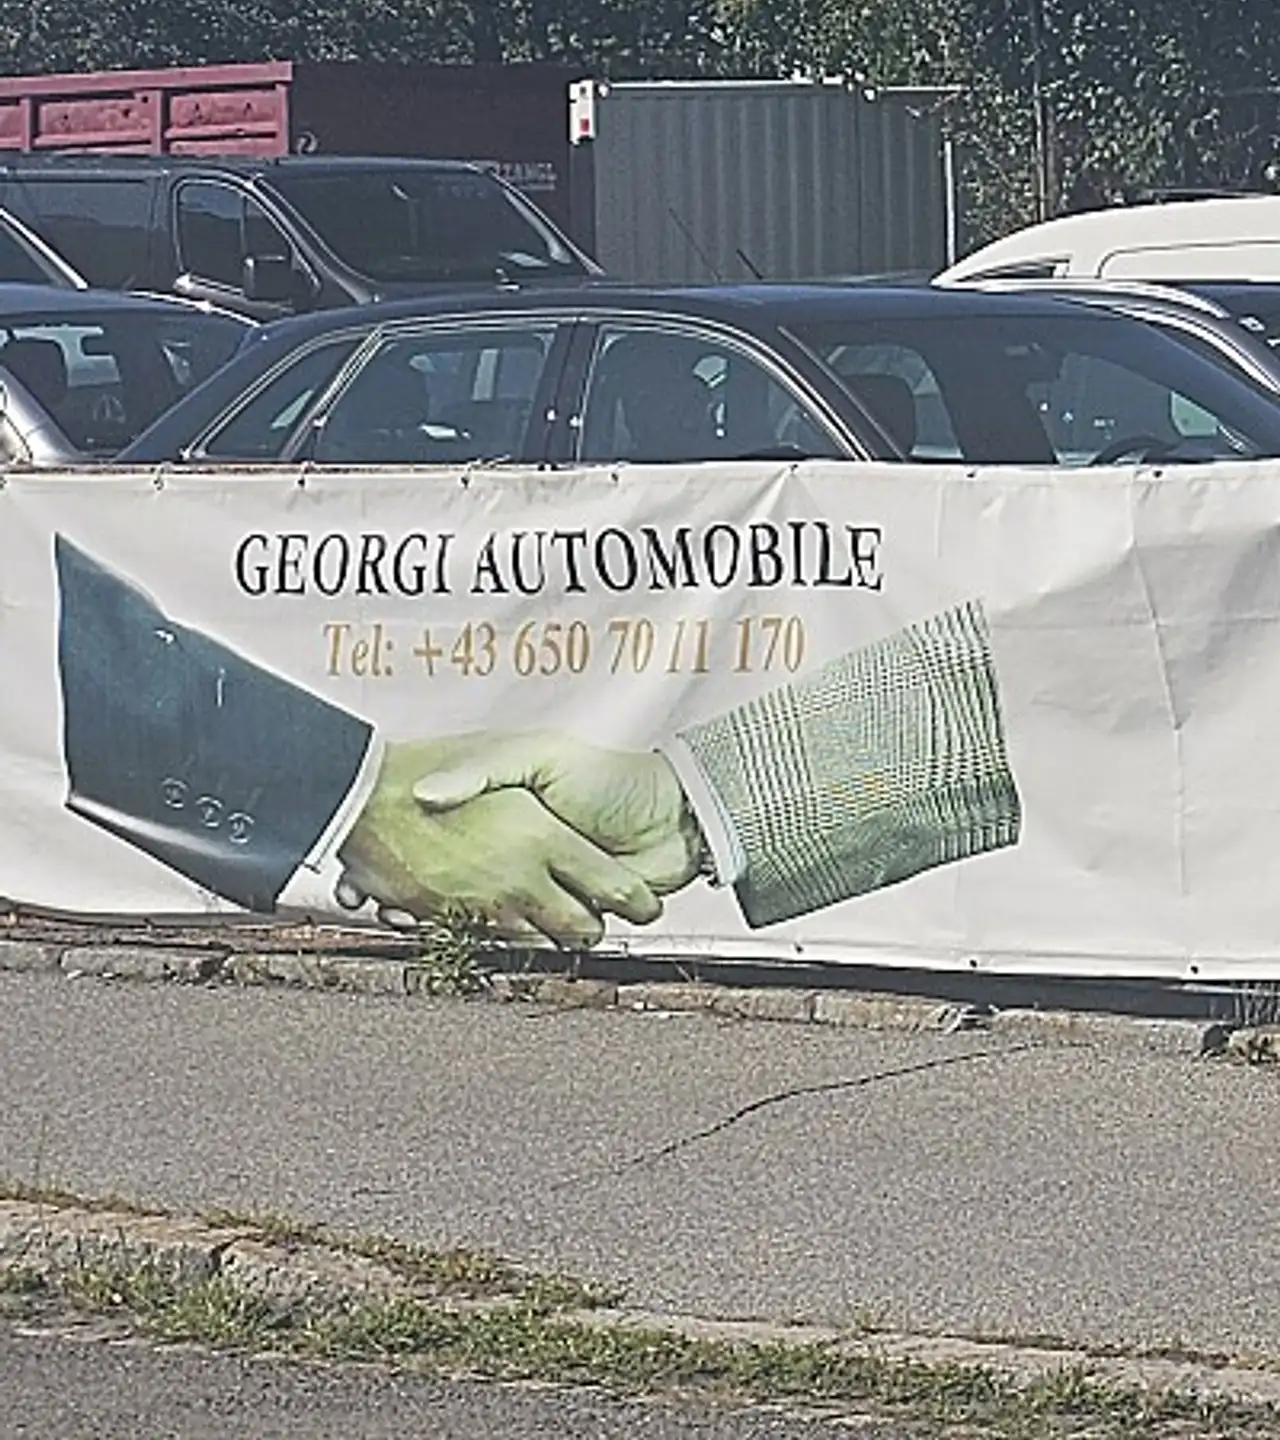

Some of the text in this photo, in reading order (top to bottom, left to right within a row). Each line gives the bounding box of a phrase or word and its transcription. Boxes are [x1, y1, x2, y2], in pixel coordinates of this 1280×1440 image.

[235, 521, 884, 597] GEORGI AUTOMOBILE
[323, 621, 393, 677] Tel:
[413, 620, 497, 677] +43
[516, 620, 590, 677] 650
[608, 617, 655, 675] 70
[736, 615, 804, 673] 170
